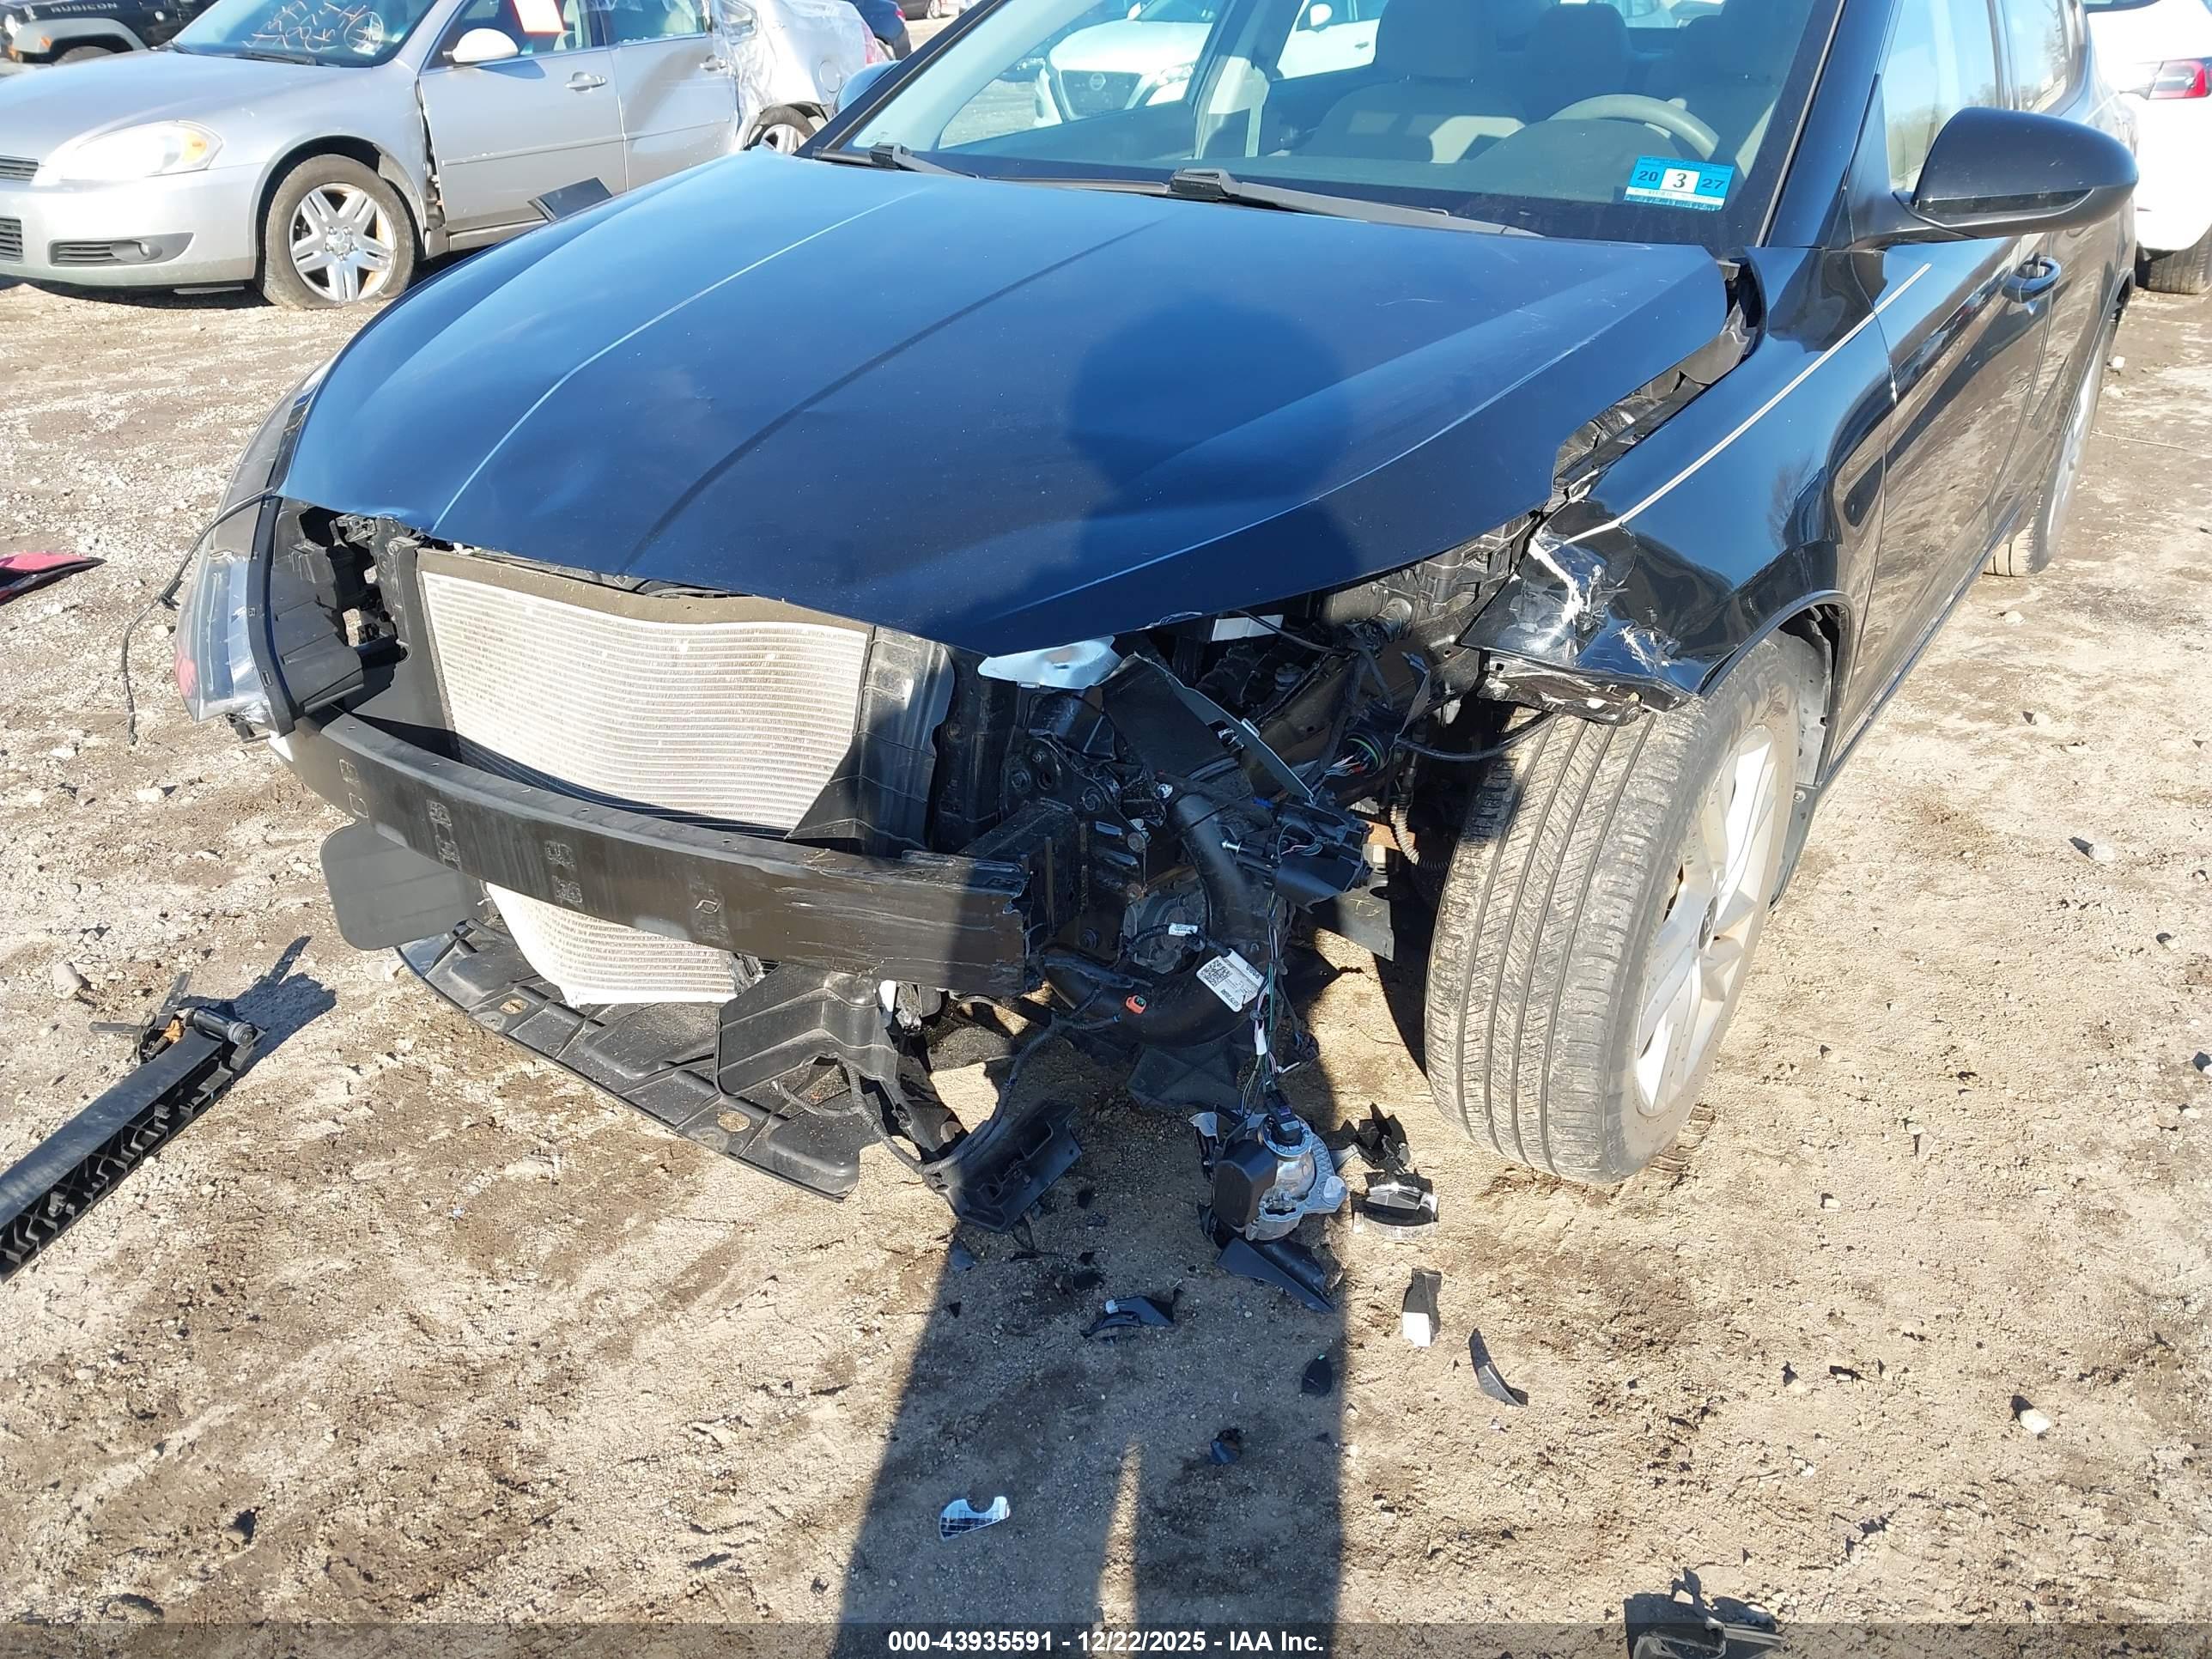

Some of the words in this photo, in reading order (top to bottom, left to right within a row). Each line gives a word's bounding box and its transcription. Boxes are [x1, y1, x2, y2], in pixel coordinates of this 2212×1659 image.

[1637, 170, 1659, 182] 20
[1672, 173, 1687, 188] 3
[1701, 178, 1725, 190] 27
